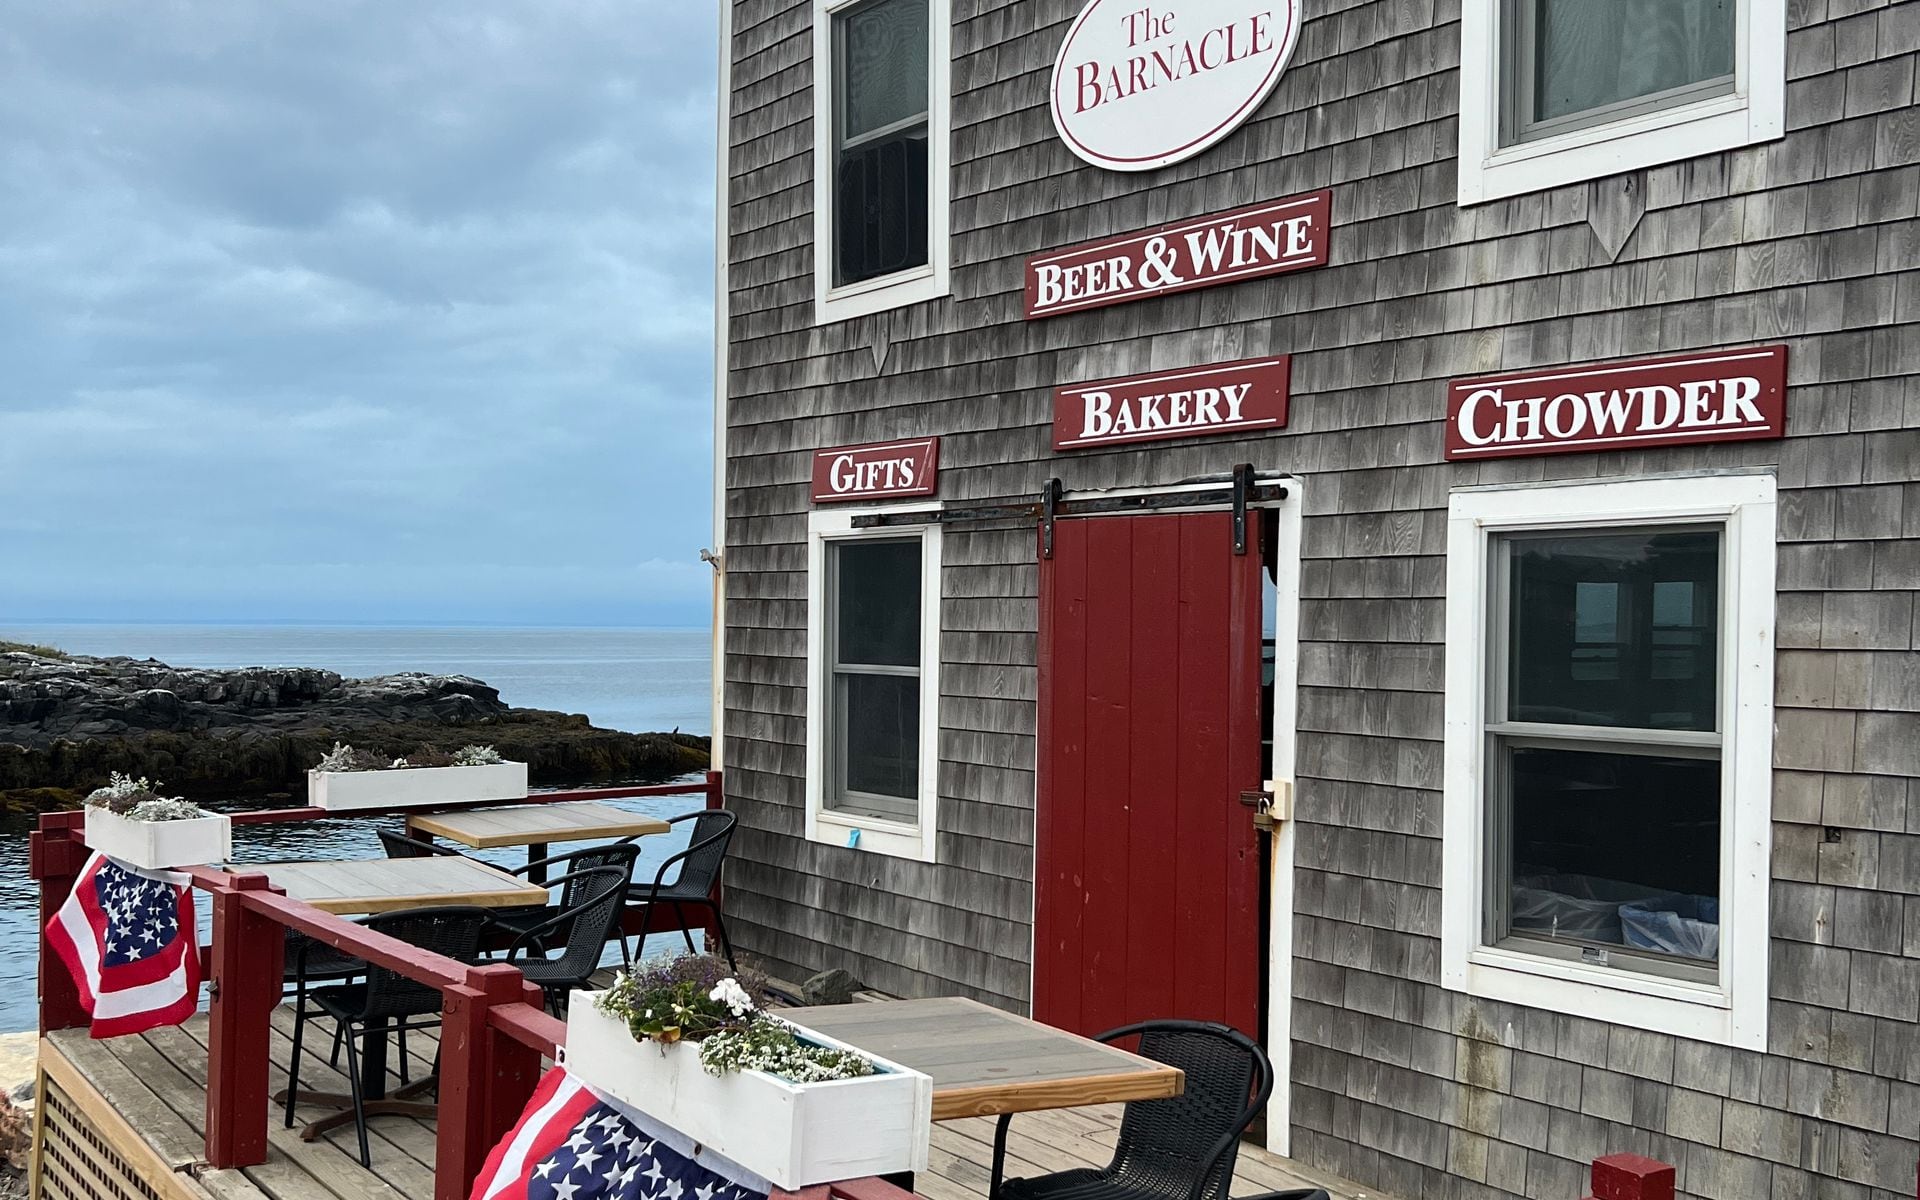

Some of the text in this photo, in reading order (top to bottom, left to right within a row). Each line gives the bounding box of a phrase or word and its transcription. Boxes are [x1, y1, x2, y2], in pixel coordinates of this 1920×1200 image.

[1121, 8, 1175, 48] The
[1073, 11, 1273, 114] BARNACLE
[1034, 215, 1312, 308] BEER & WINE
[1079, 382, 1252, 438] BAKERY
[1457, 376, 1765, 446] CHOWDER
[829, 454, 914, 493] GIFTS
